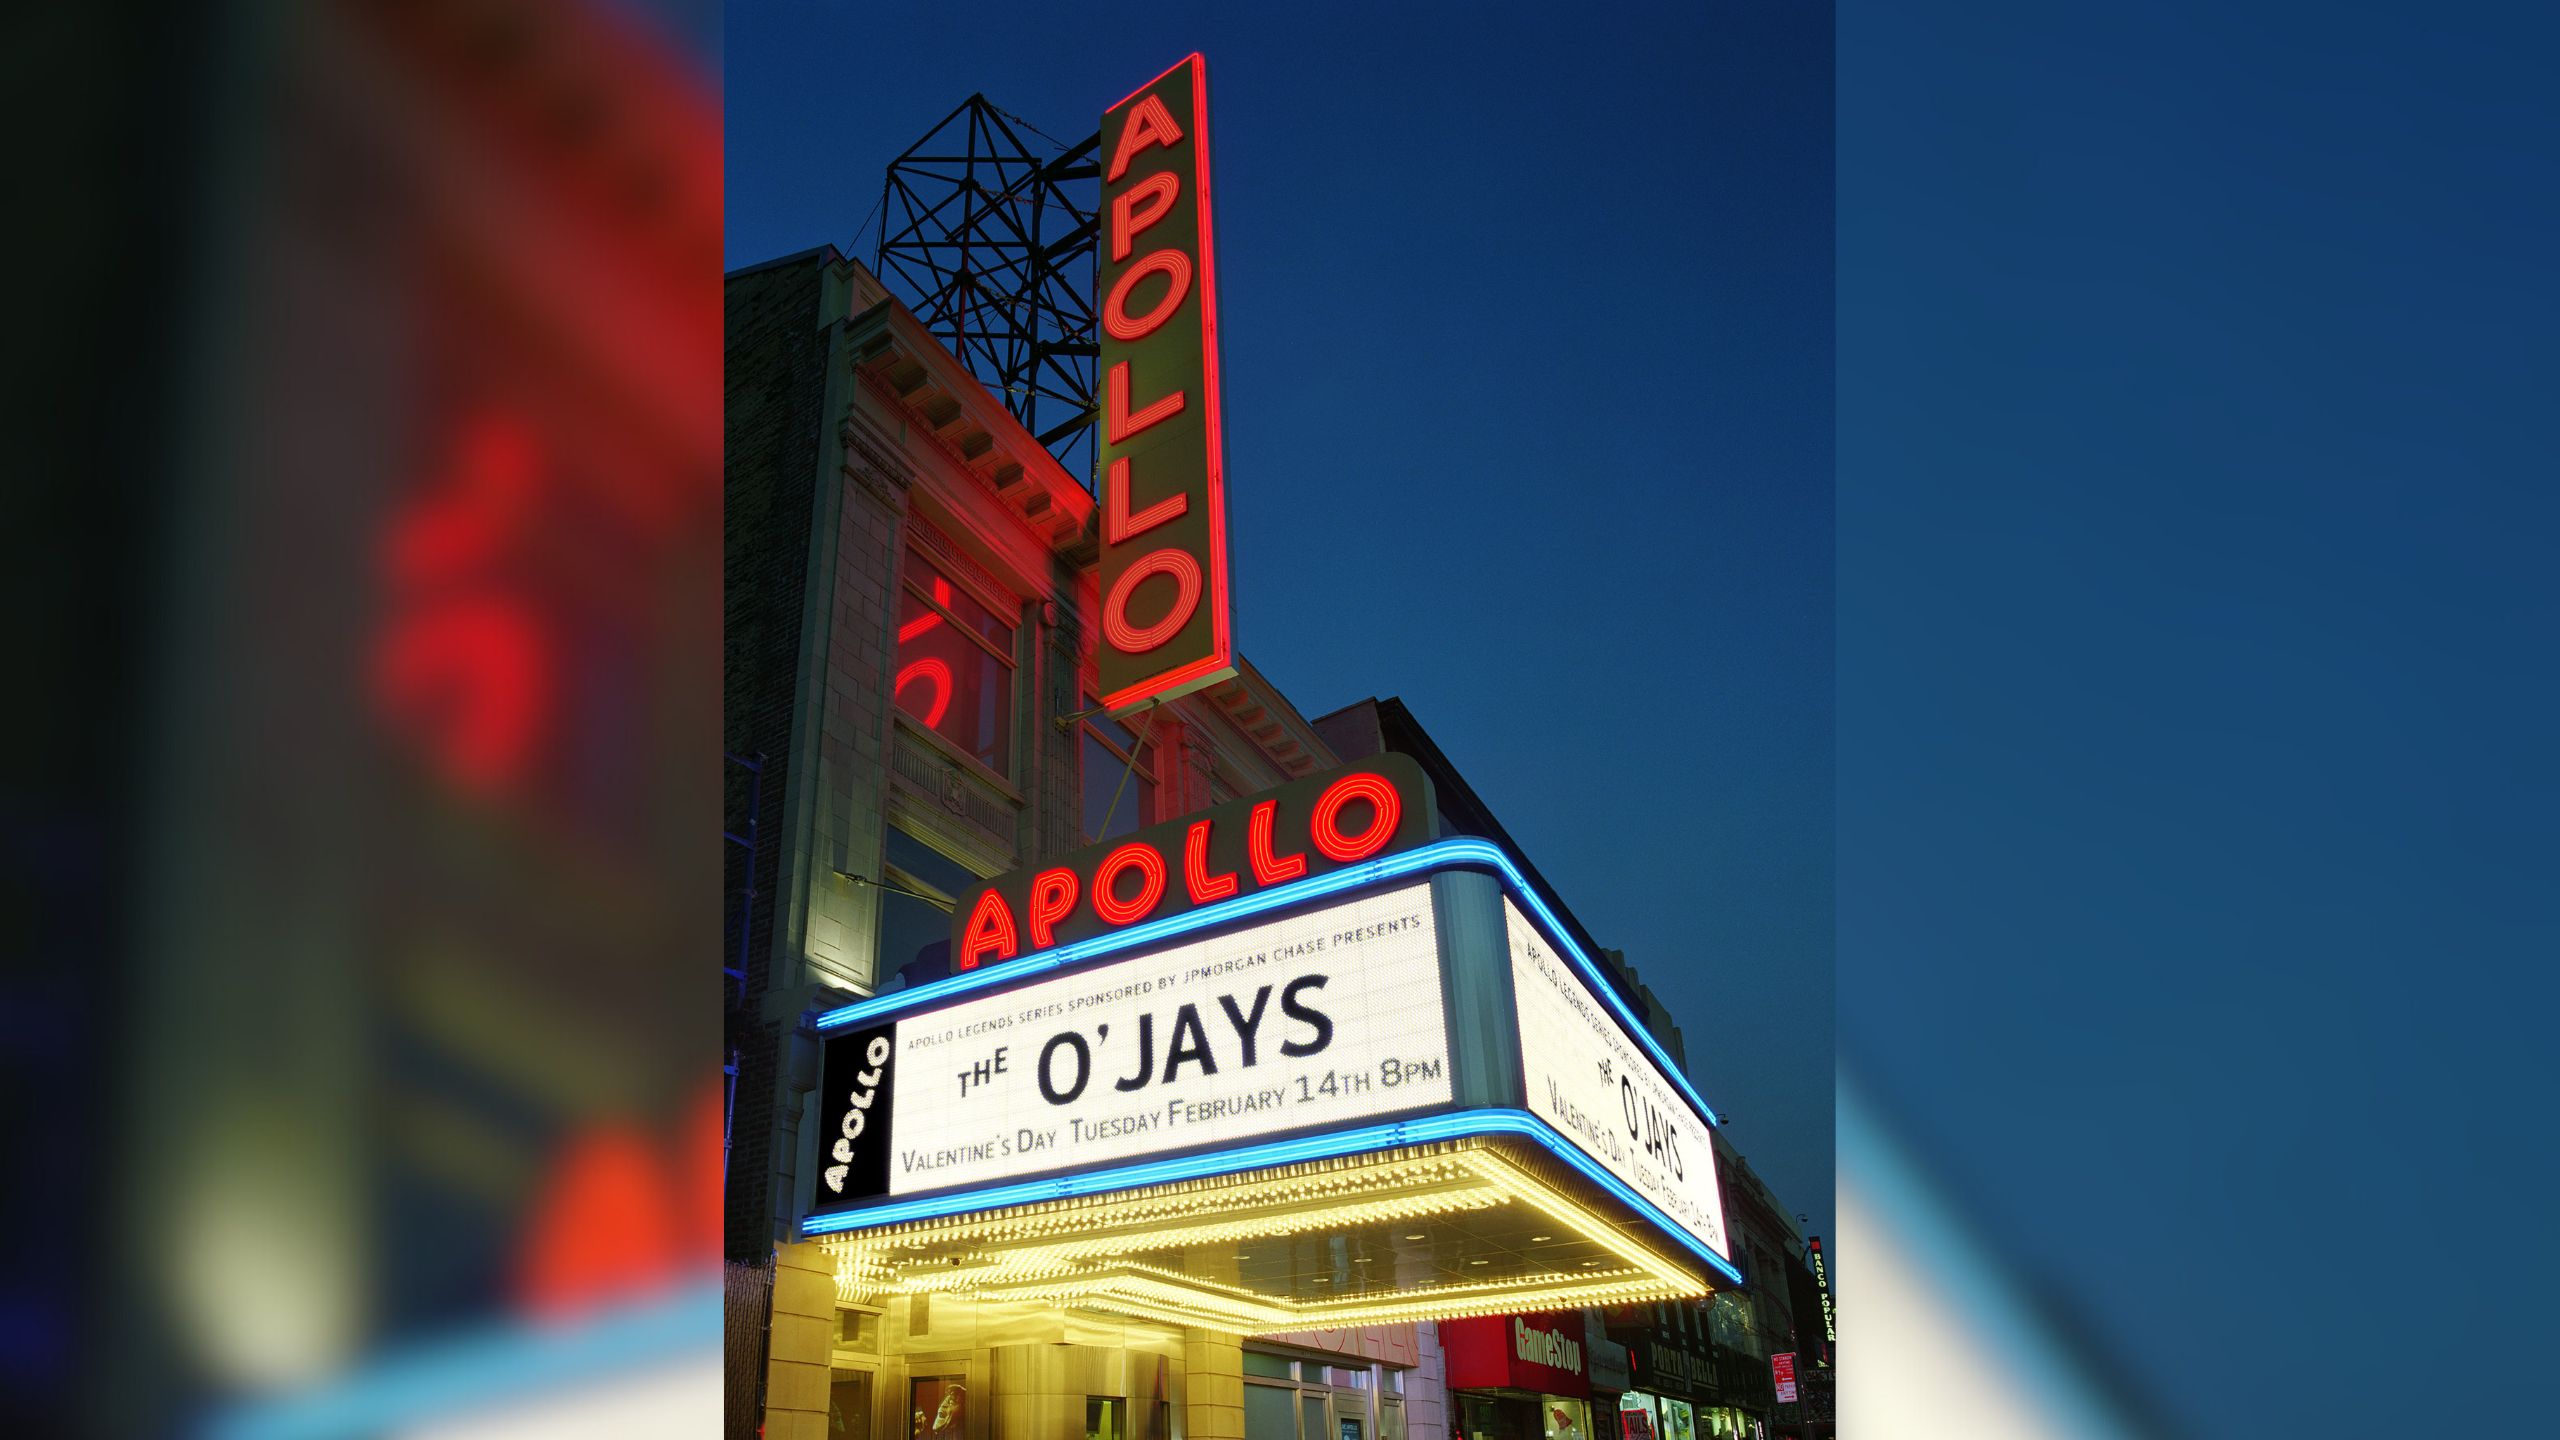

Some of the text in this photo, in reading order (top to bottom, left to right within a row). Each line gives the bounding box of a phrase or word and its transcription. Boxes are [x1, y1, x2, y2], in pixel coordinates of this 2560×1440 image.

[1103, 93, 1203, 654] APOLLO
[960, 772, 1402, 971] APOLLO
[908, 914, 1422, 1051] APOLLO LEGENDS SERIES SPONSORED BY JPMORGAN CHASE PRESENTS
[1527, 942, 1558, 987] APOLLO
[957, 973, 1334, 1106] THE O'JAYS
[1597, 1057, 1614, 1088] THE
[824, 1036, 890, 1194] APOLLO
[1017, 1128, 1057, 1154] DAY
[1070, 1111, 1161, 1144] TUESDAY
[1167, 1088, 1286, 1127] FEBRUARY
[1294, 1069, 1371, 1103] 14TH
[1379, 1057, 1442, 1088] 8PM
[1813, 1252, 1827, 1288] BANCO
[1821, 1293, 1836, 1342] POPULAR
[1515, 1316, 1581, 1376] GameStop
[1650, 1341, 1684, 1377] PORTA
[1690, 1355, 1719, 1386] BELLA
